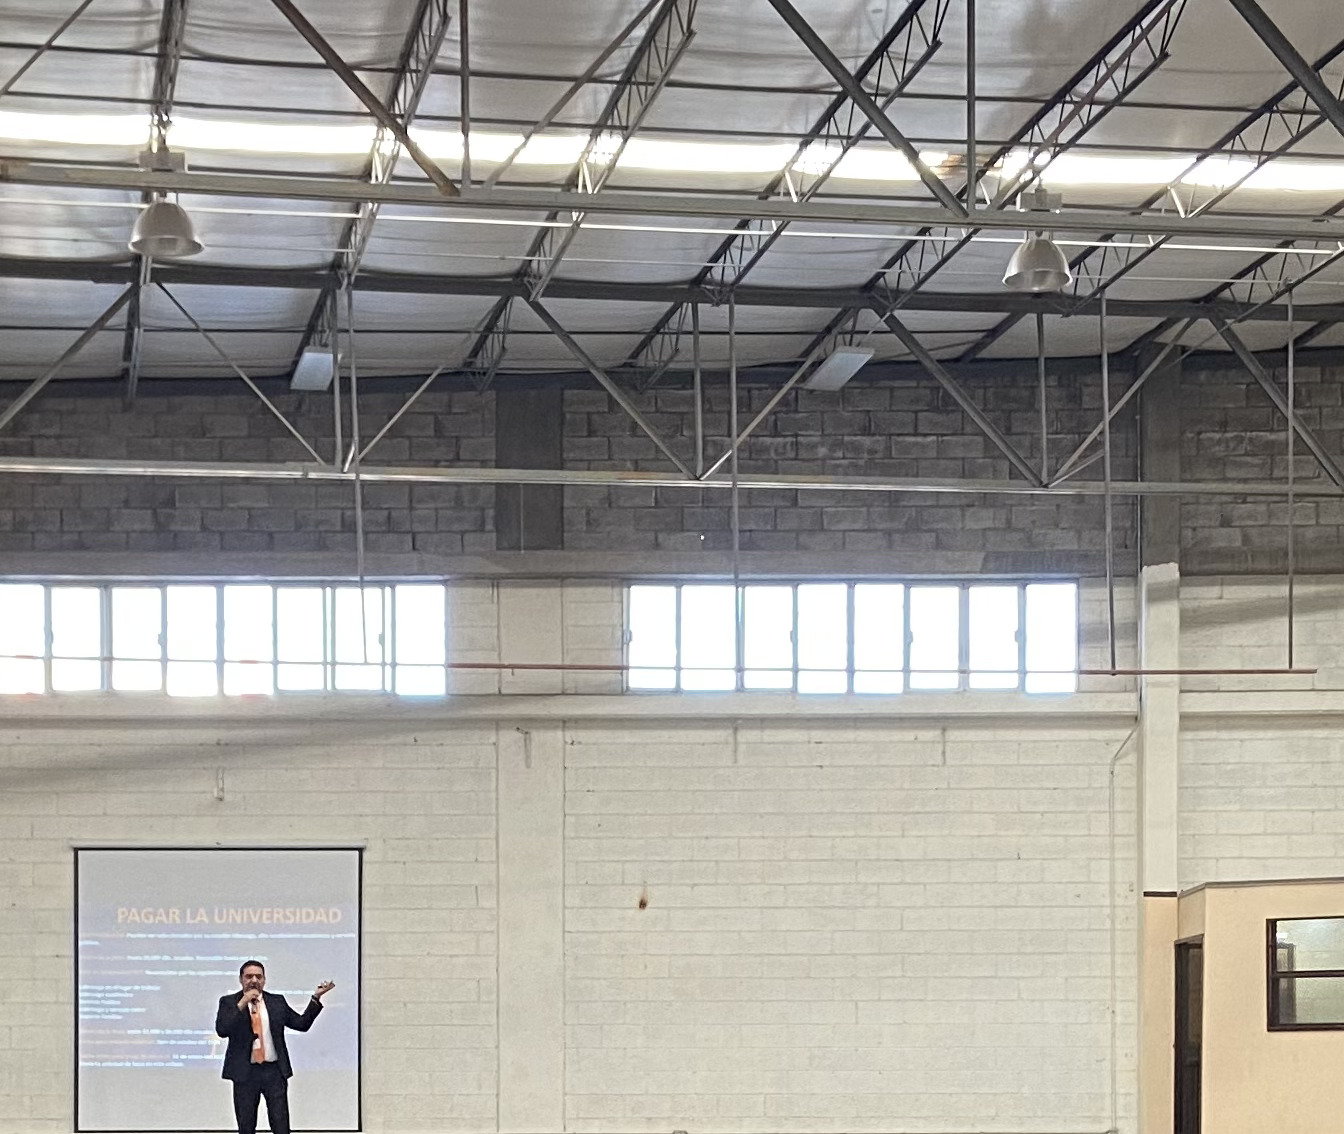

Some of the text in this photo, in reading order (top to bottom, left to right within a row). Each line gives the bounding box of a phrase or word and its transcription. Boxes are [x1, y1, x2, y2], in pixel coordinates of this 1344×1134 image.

[116, 907, 342, 925] PAGAR LA UNIVERSIDAD
